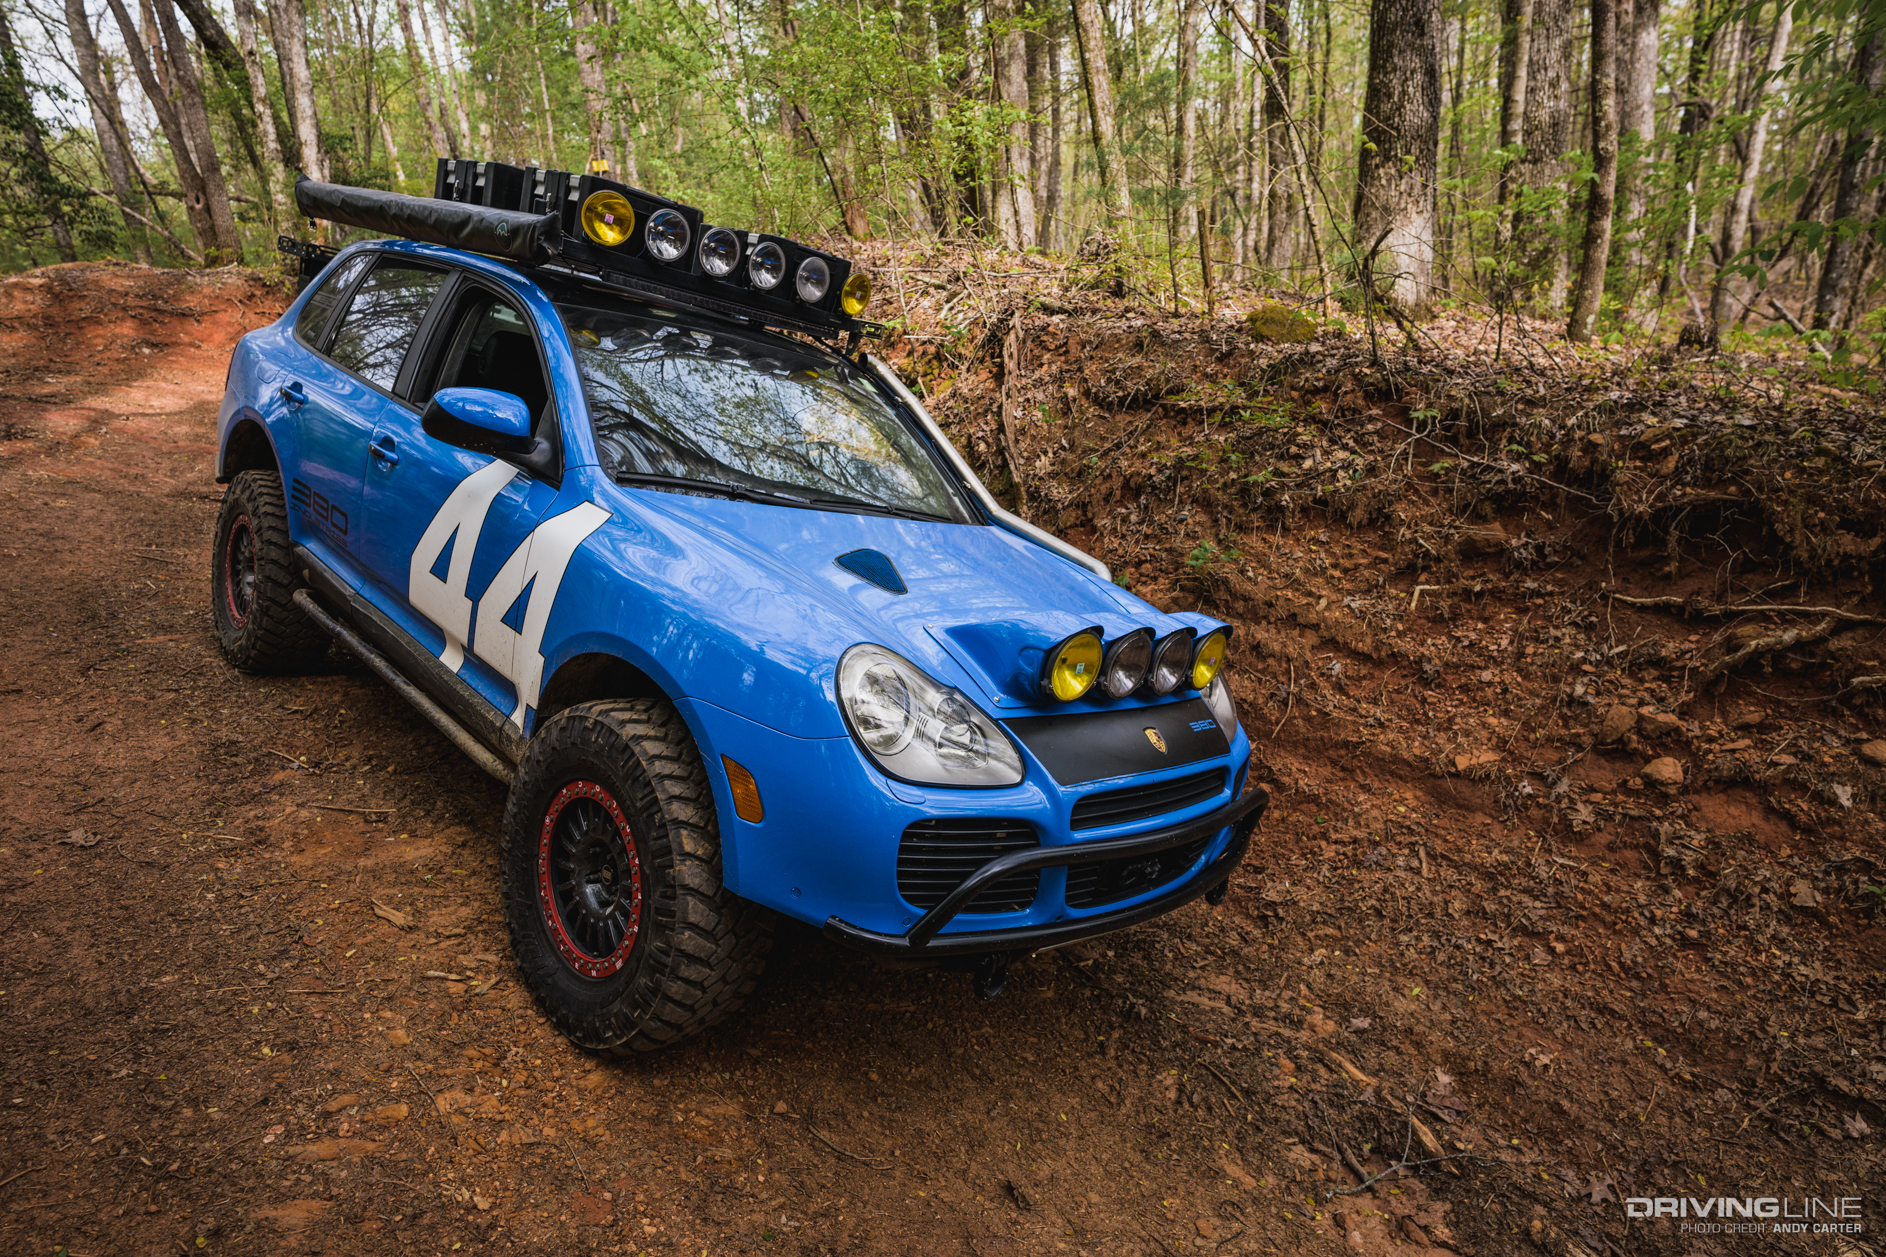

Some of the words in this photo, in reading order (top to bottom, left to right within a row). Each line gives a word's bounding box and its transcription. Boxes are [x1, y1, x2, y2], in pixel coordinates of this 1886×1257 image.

[290, 501, 349, 549] INDUSTRIES
[291, 477, 348, 536] 380
[408, 458, 614, 735] 44
[1189, 719, 1217, 732] 380
